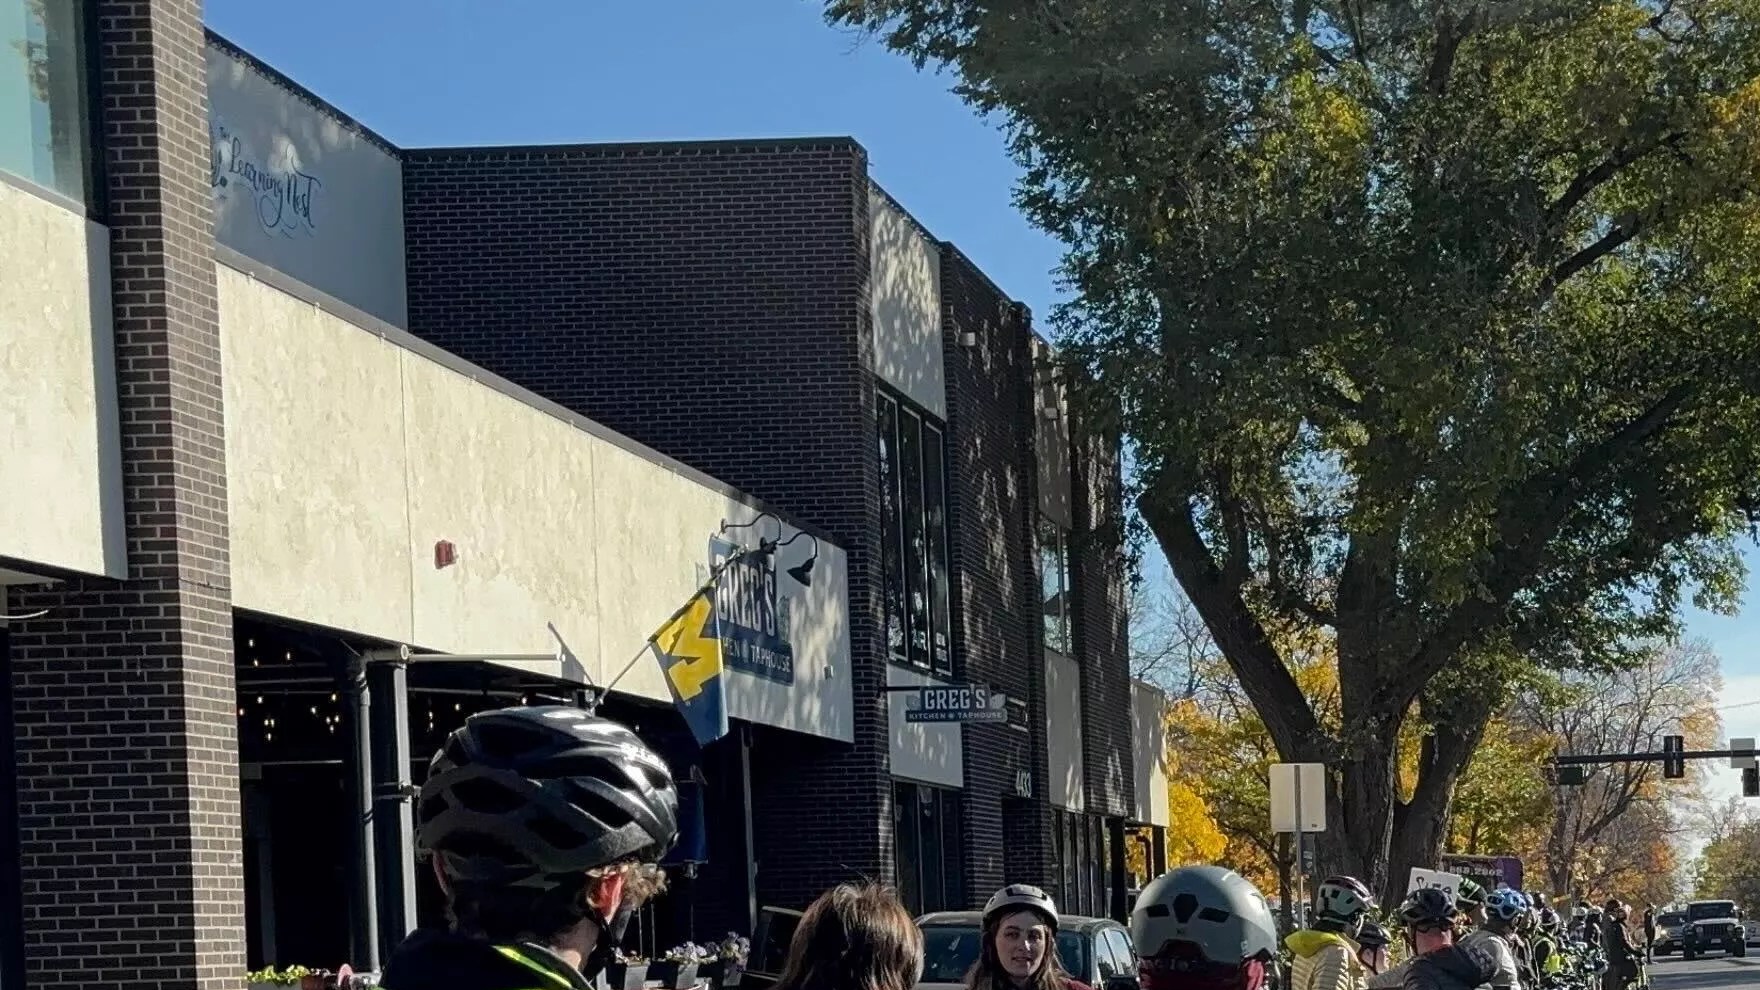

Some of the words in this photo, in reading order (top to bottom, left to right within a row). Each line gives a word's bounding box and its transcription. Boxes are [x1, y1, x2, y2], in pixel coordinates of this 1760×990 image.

[229, 137, 283, 228] Learning
[284, 144, 321, 228] Nest
[750, 644, 791, 673] TAPHOUSE
[924, 684, 986, 710] GREG'S
[909, 711, 946, 719] KITCHEN
[957, 711, 1003, 719] TAPHOUSE
